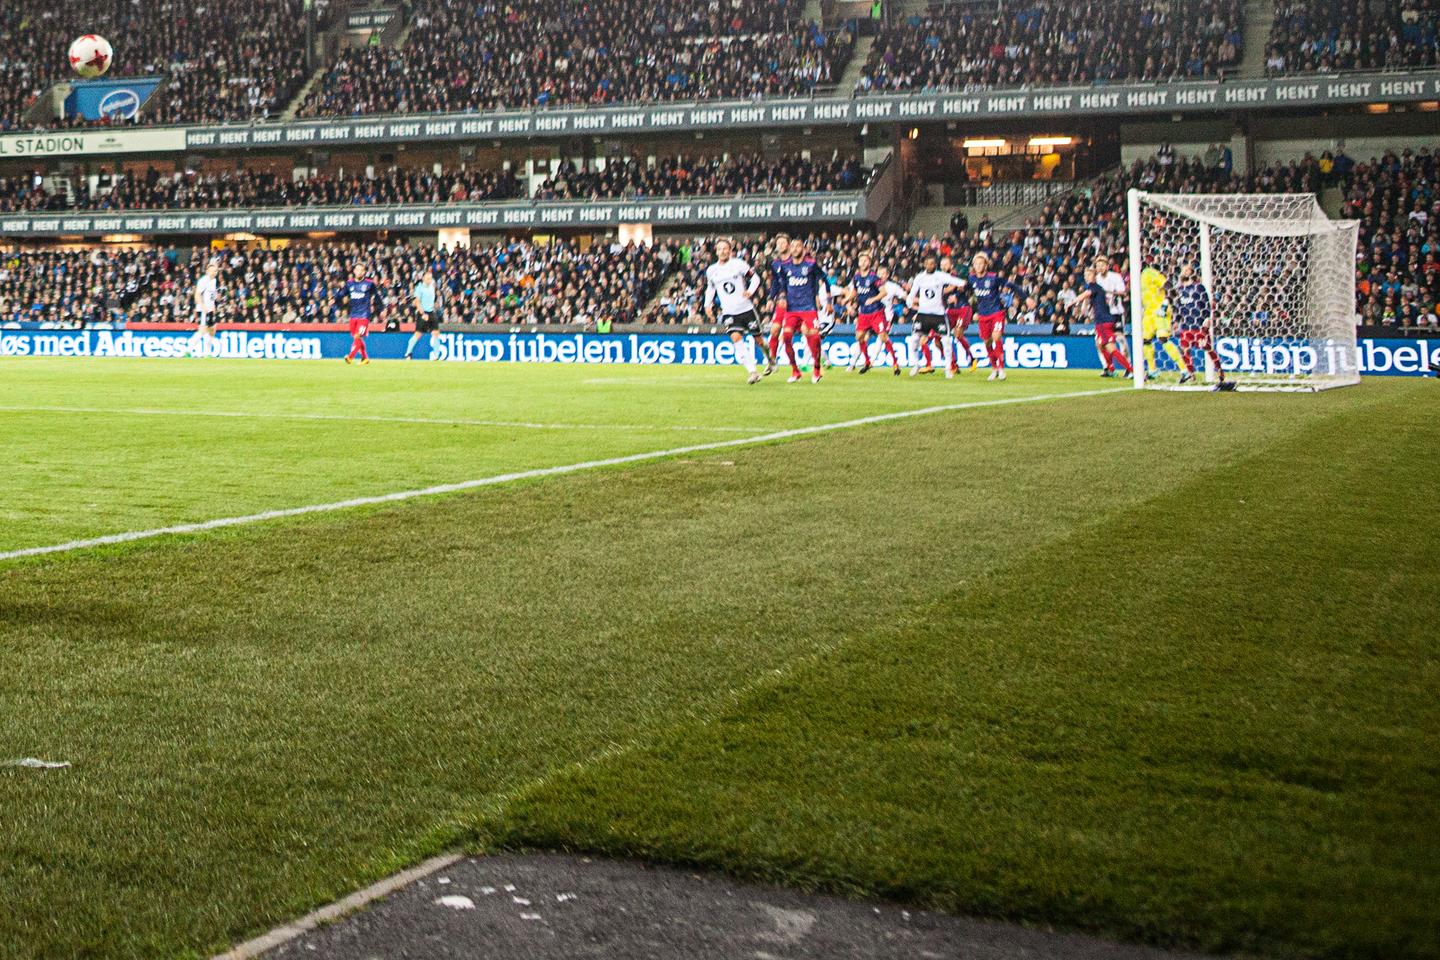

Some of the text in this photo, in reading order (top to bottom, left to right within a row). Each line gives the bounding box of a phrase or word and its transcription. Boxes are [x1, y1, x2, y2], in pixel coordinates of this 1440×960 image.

[187, 132, 215, 145] HENT
[219, 131, 249, 144] HENT
[253, 130, 282, 142] HENT
[286, 128, 316, 141] HENT
[320, 126, 350, 139] HENT
[354, 125, 385, 138] HENT
[390, 123, 420, 137] HENT
[425, 121, 456, 135] HENT
[461, 120, 493, 134] HENT
[498, 118, 530, 132] HENT
[535, 117, 568, 130] HENT
[573, 115, 606, 129] HENT
[612, 113, 645, 127] HENT
[651, 111, 685, 126] HENT
[690, 110, 724, 124] HENT
[731, 108, 765, 122] HENT
[772, 106, 807, 121] HENT
[813, 104, 850, 119] HENT
[856, 102, 892, 117] HENT
[899, 101, 936, 115] HENT
[943, 99, 980, 114] HENT
[987, 97, 1026, 112] HENT
[1033, 95, 1072, 110] HENT
[1080, 93, 1119, 108] HENT
[1127, 91, 1167, 106] HENT
[1176, 89, 1217, 104] HENT
[1225, 87, 1267, 102] HENT
[1276, 85, 1318, 100] HENT
[1327, 83, 1370, 98] HENT
[1380, 81, 1425, 95] HENT
[15, 136, 85, 153] STADION
[32, 220, 60, 231] HENT
[93, 219, 122, 230] HENT
[125, 218, 153, 230] HENT
[157, 217, 186, 230] HENT
[190, 217, 219, 229] HENT
[223, 216, 252, 228] HENT
[256, 215, 286, 228] HENT
[290, 214, 320, 227] HENT
[324, 214, 354, 226] HENT
[358, 213, 390, 226] HENT
[394, 212, 425, 225] HENT
[430, 211, 462, 224] HENT
[466, 210, 498, 224] HENT
[503, 209, 536, 223] HENT
[541, 208, 574, 222] HENT
[579, 207, 612, 221] HENT
[618, 206, 652, 220] HENT
[657, 205, 691, 220] HENT
[697, 205, 732, 219] HENT
[738, 203, 773, 218] HENT
[779, 202, 815, 217] HENT
[821, 201, 858, 216] HENT
[33, 330, 92, 357] med
[430, 333, 504, 363] Slipp
[508, 333, 626, 364] jubelen
[628, 333, 677, 365] løs
[1215, 337, 1318, 375] Slipp
